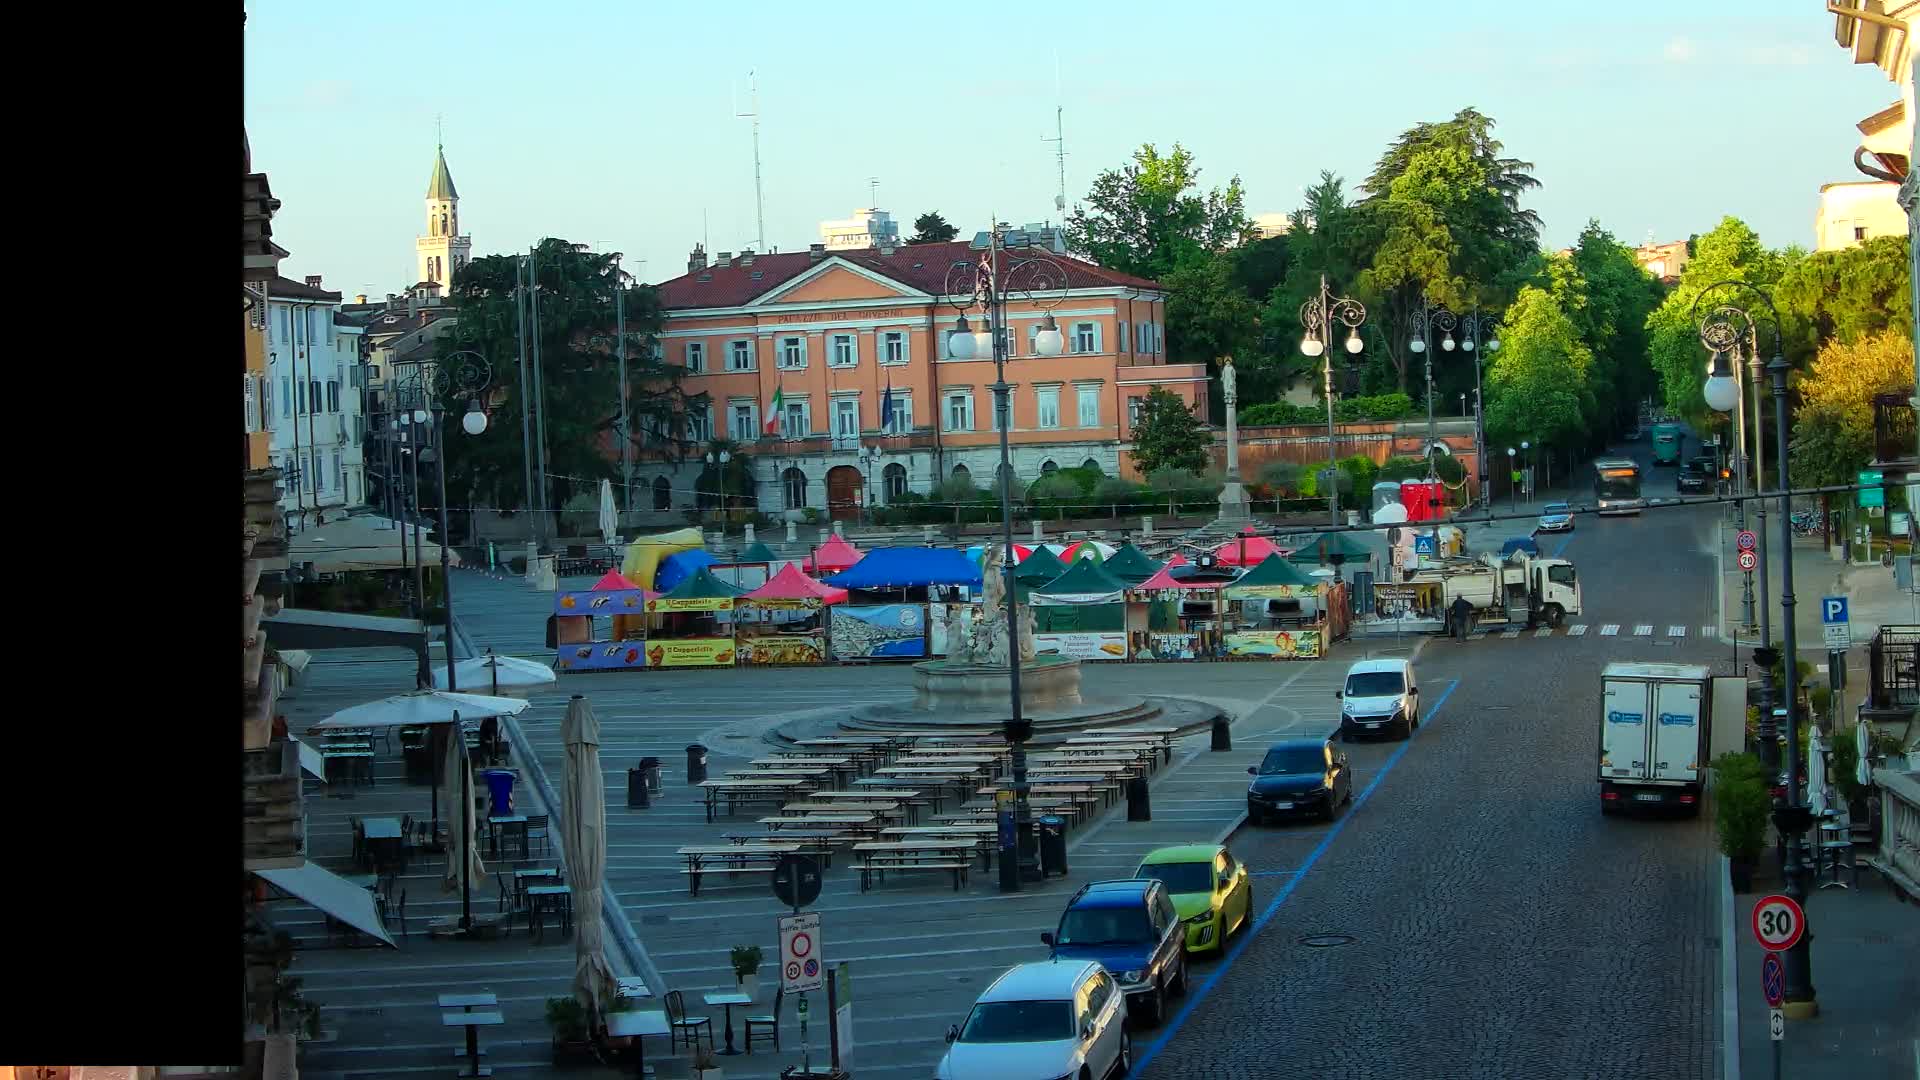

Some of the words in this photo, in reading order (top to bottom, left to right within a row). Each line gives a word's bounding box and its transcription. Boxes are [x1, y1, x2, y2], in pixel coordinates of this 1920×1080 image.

[1742, 557, 1752, 565] 20
[1828, 601, 1843, 620] P
[1762, 910, 1792, 937] 30
